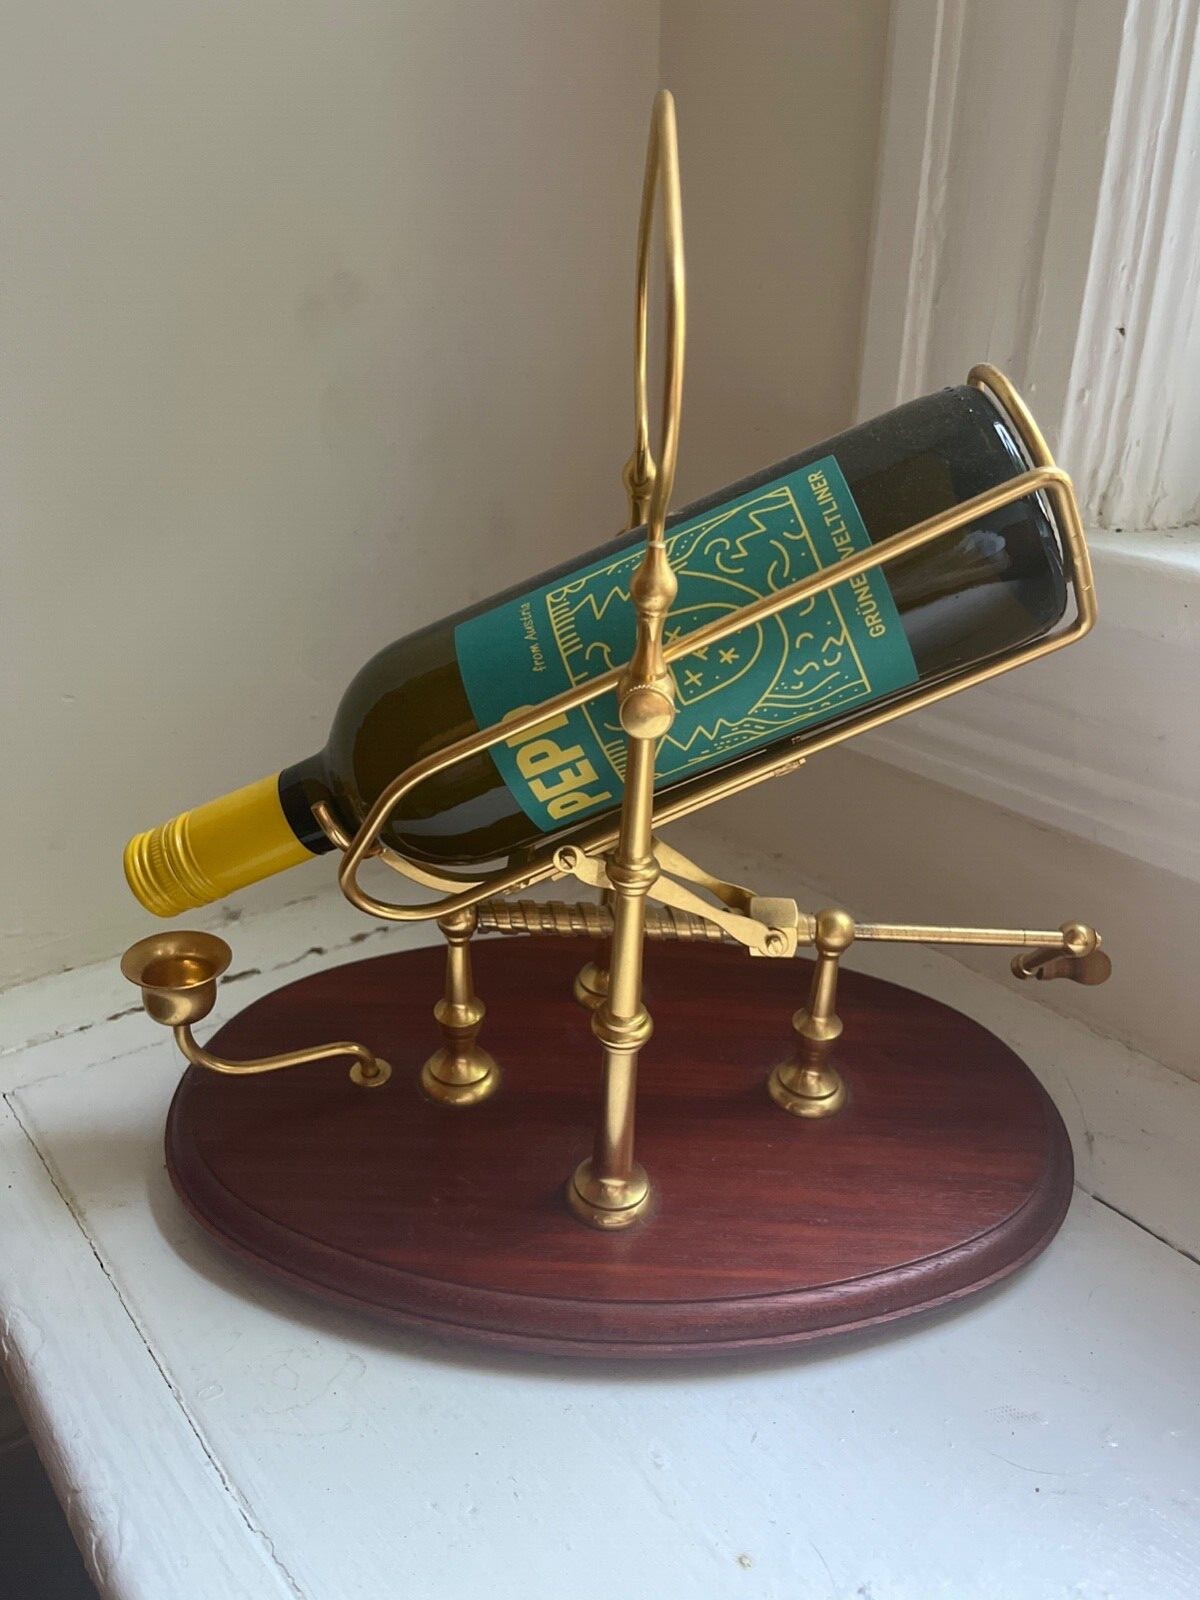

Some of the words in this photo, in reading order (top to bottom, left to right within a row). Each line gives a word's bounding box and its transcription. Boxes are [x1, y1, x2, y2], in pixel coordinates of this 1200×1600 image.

[807, 469, 855, 560] VELTLINER
[520, 602, 538, 640] Austria
[848, 568, 886, 638] GRÜNE
[530, 642, 547, 672] from
